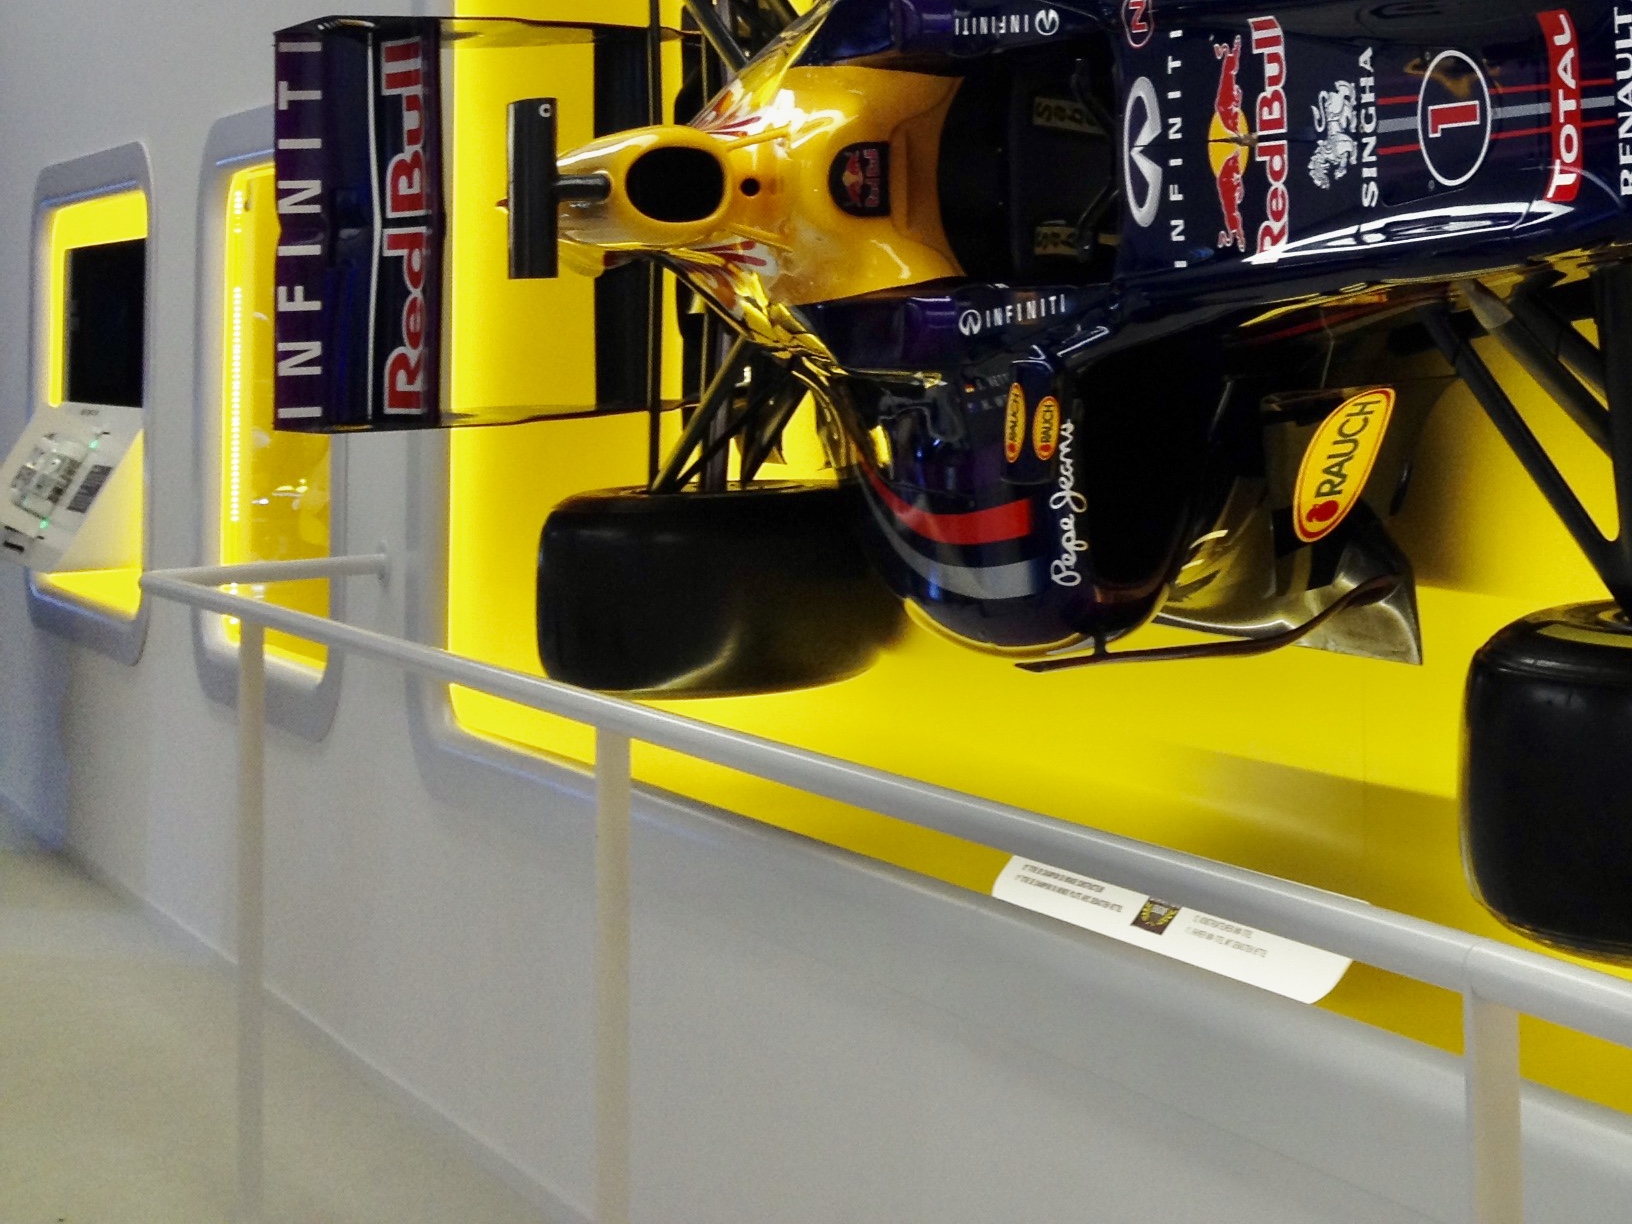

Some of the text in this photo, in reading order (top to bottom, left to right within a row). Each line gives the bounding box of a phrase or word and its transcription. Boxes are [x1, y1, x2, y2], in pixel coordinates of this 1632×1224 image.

[954, 14, 1030, 37] INFINITI
[1548, 13, 1579, 200] TOTAL
[1166, 28, 1188, 269] INFINITI
[1246, 13, 1289, 266] Red Bull
[1358, 46, 1379, 208] SINGHA
[1428, 99, 1481, 138] 1
[277, 40, 323, 419] INFINITI
[381, 35, 428, 415] Red Bull
[985, 293, 1067, 330] INFINITI
[1008, 391, 1021, 443] RAUCH
[1041, 404, 1054, 444] RAUCH
[1314, 396, 1382, 498] RAUCH
[1049, 418, 1089, 587] Pepe Jeans
